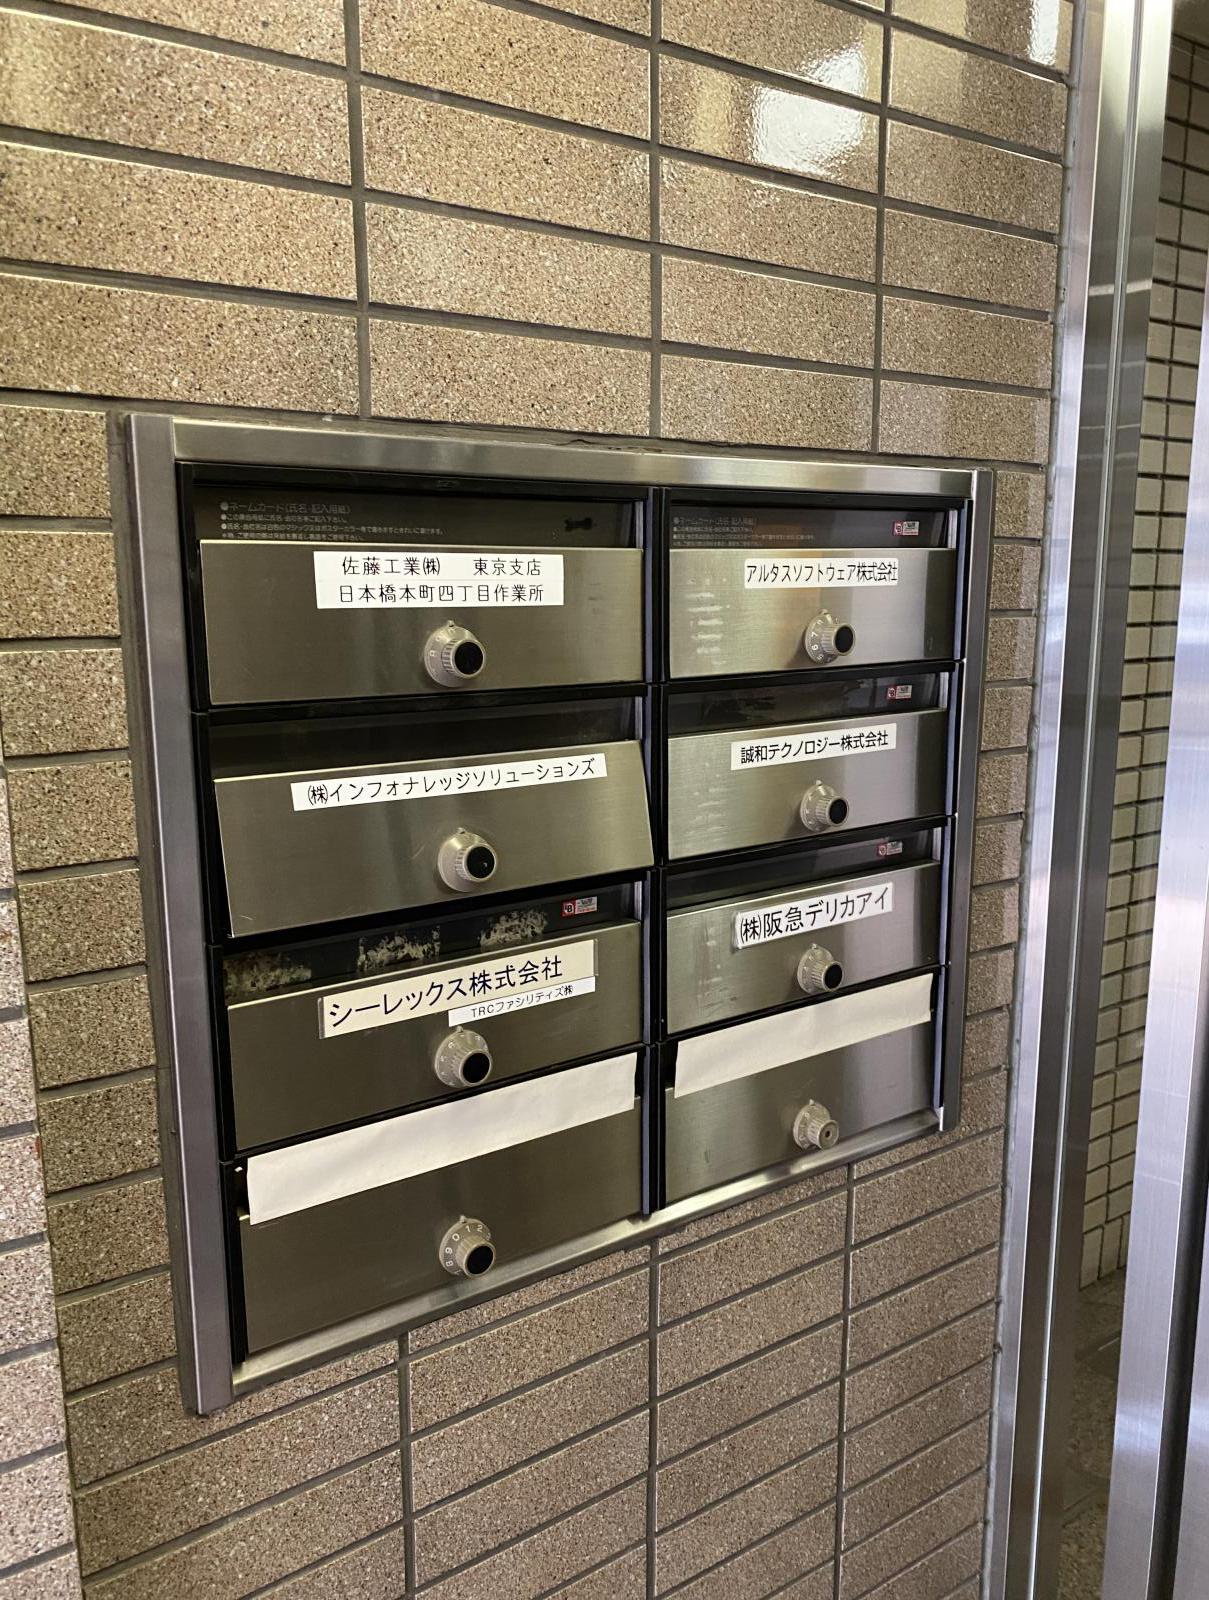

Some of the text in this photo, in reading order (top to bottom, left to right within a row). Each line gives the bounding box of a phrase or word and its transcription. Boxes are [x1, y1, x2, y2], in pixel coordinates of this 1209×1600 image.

[473, 558, 542, 576] 東京支店
[746, 561, 898, 583] アルタスソフトウェア株式会社
[339, 584, 544, 603] 日本橋本町四丁目作業所
[740, 730, 889, 764] 誠和テクノロジー株式会社
[329, 955, 563, 1028] シーレックス株式会社
